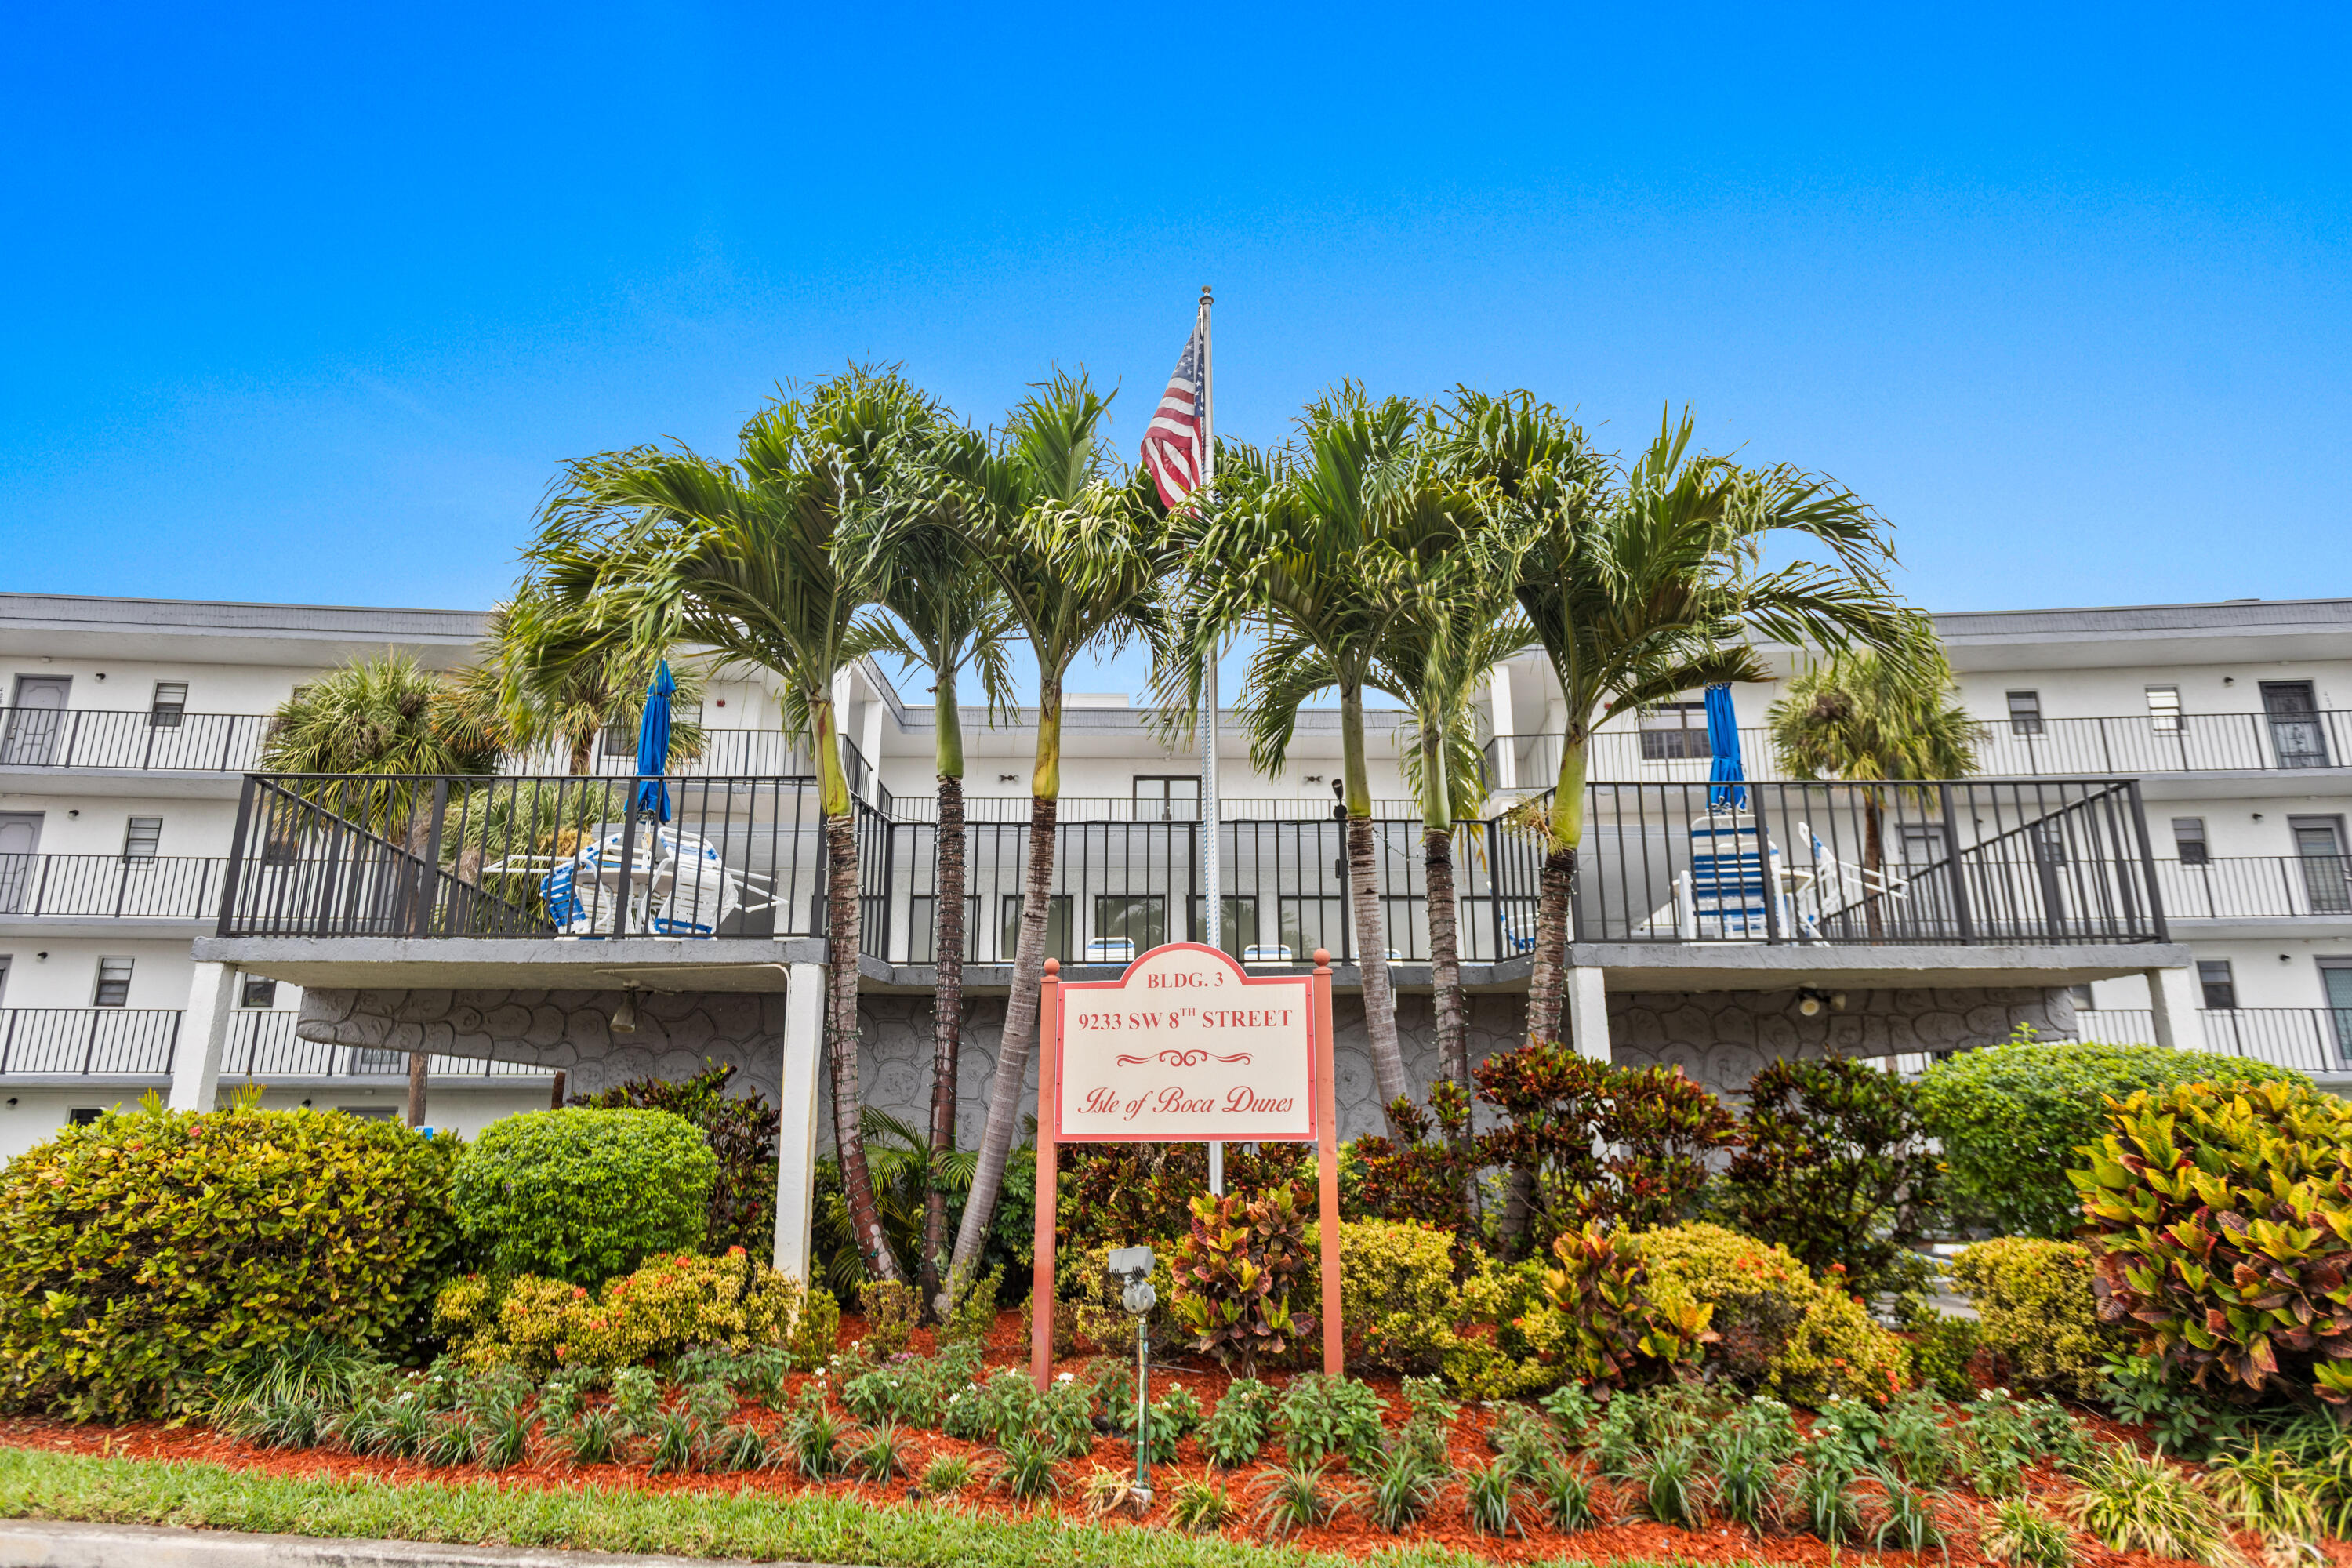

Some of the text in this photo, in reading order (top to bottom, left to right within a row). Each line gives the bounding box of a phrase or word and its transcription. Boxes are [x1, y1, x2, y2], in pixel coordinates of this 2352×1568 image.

[1148, 972, 1223, 989] BLDG. 3
[1079, 1013, 1121, 1030] 9233
[1129, 1012, 1162, 1029] SW
[1203, 1010, 1292, 1028] STREET
[1077, 1086, 1293, 1121] Isle of Boca Dunes
